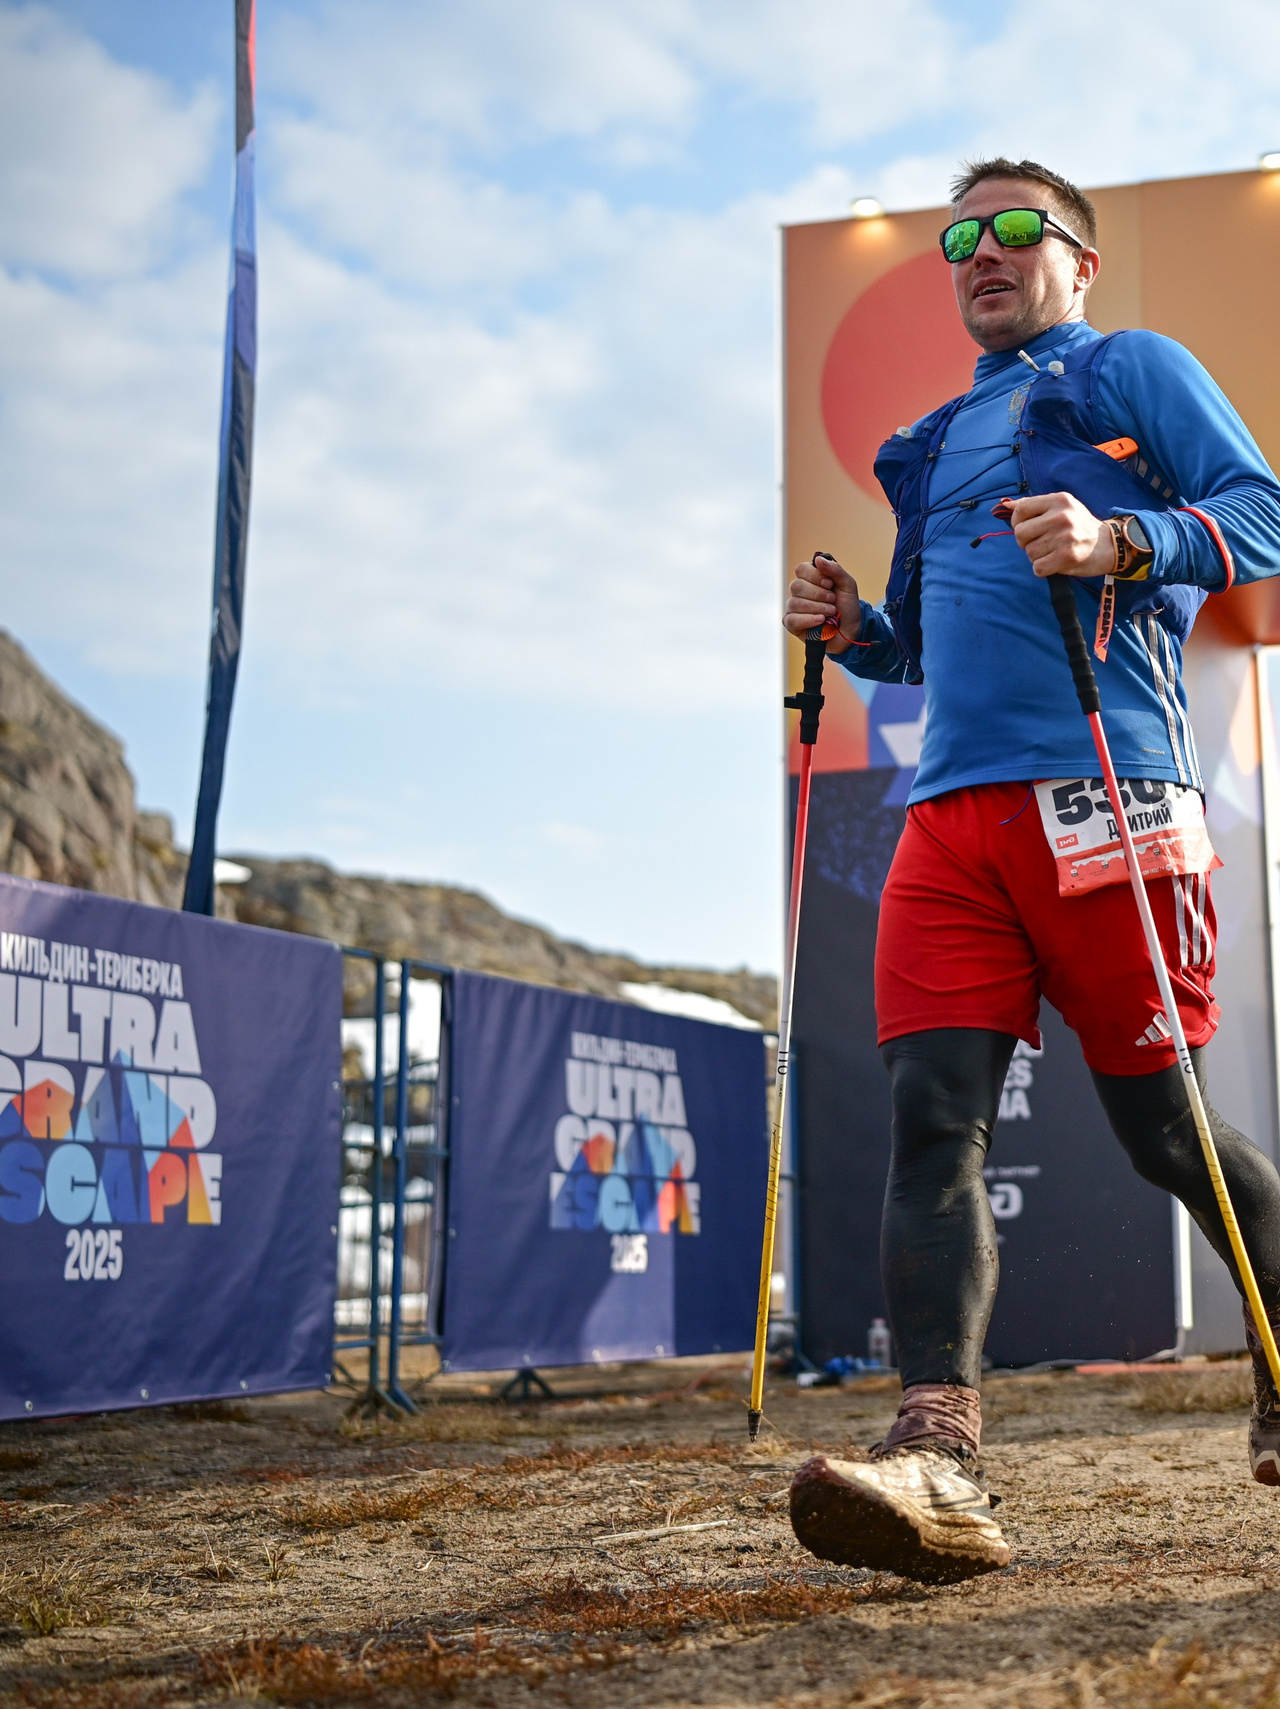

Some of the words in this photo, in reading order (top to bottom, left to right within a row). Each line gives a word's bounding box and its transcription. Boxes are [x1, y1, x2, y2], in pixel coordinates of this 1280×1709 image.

[1106, 803, 1174, 840] ДИТРИЙ
[1, 931, 184, 999] КИЛЬДИН-ТЕРИБЕРКА
[565, 1057, 688, 1128] ULTRA
[554, 1113, 698, 1181] GRAND
[0, 1139, 223, 1226] SCAPE
[549, 1172, 701, 1235] ESCAPE
[64, 1228, 123, 1281] 2025
